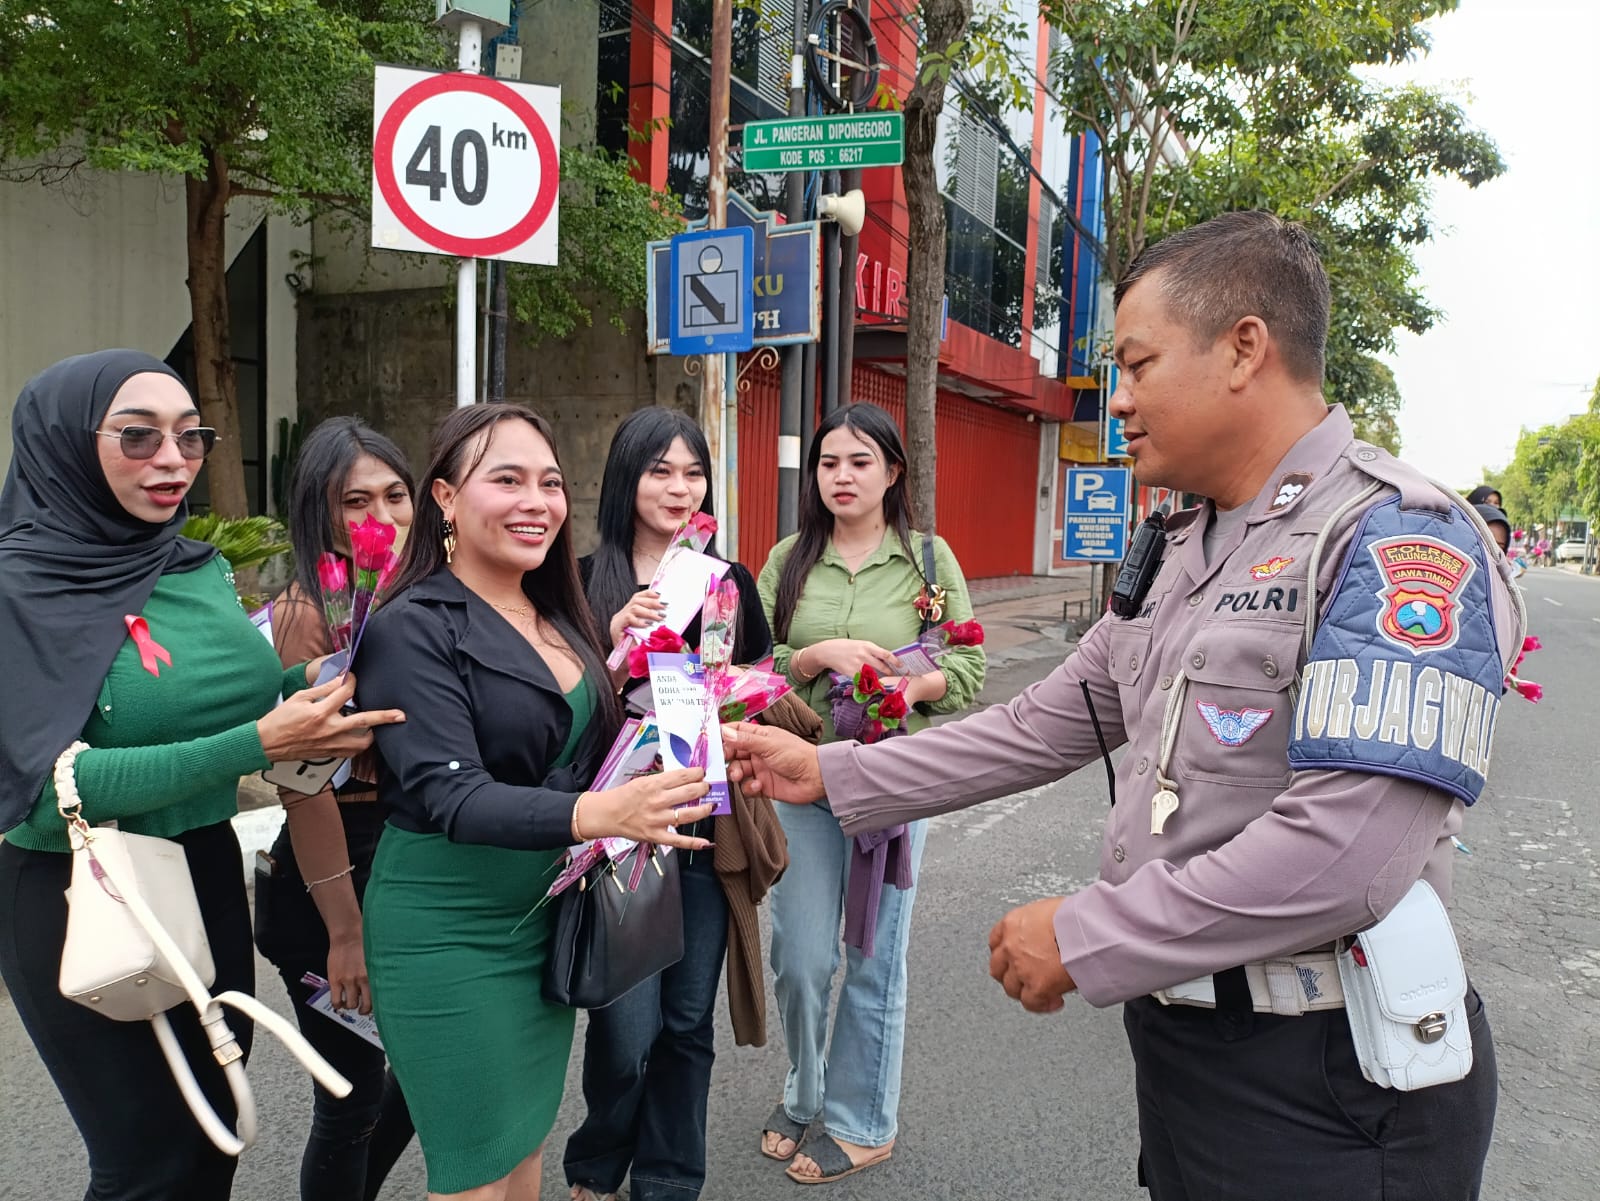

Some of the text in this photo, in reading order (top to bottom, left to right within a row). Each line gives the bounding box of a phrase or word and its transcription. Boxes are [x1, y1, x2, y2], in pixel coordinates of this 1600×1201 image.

[754, 120, 892, 144] JL. PANGERAN DIPONEGORO
[405, 121, 527, 206] 40 km
[780, 151, 803, 165] KODE
[809, 149, 825, 164] POS
[839, 147, 863, 162] 66217
[1074, 473, 1104, 501] P
[1097, 516, 1122, 525] MOBIL
[1385, 545, 1463, 569] POLRES
[1390, 552, 1459, 574] TULUNGAGUNG
[1394, 570, 1453, 588] JAWA TIMUR
[1214, 587, 1298, 613] POLRI
